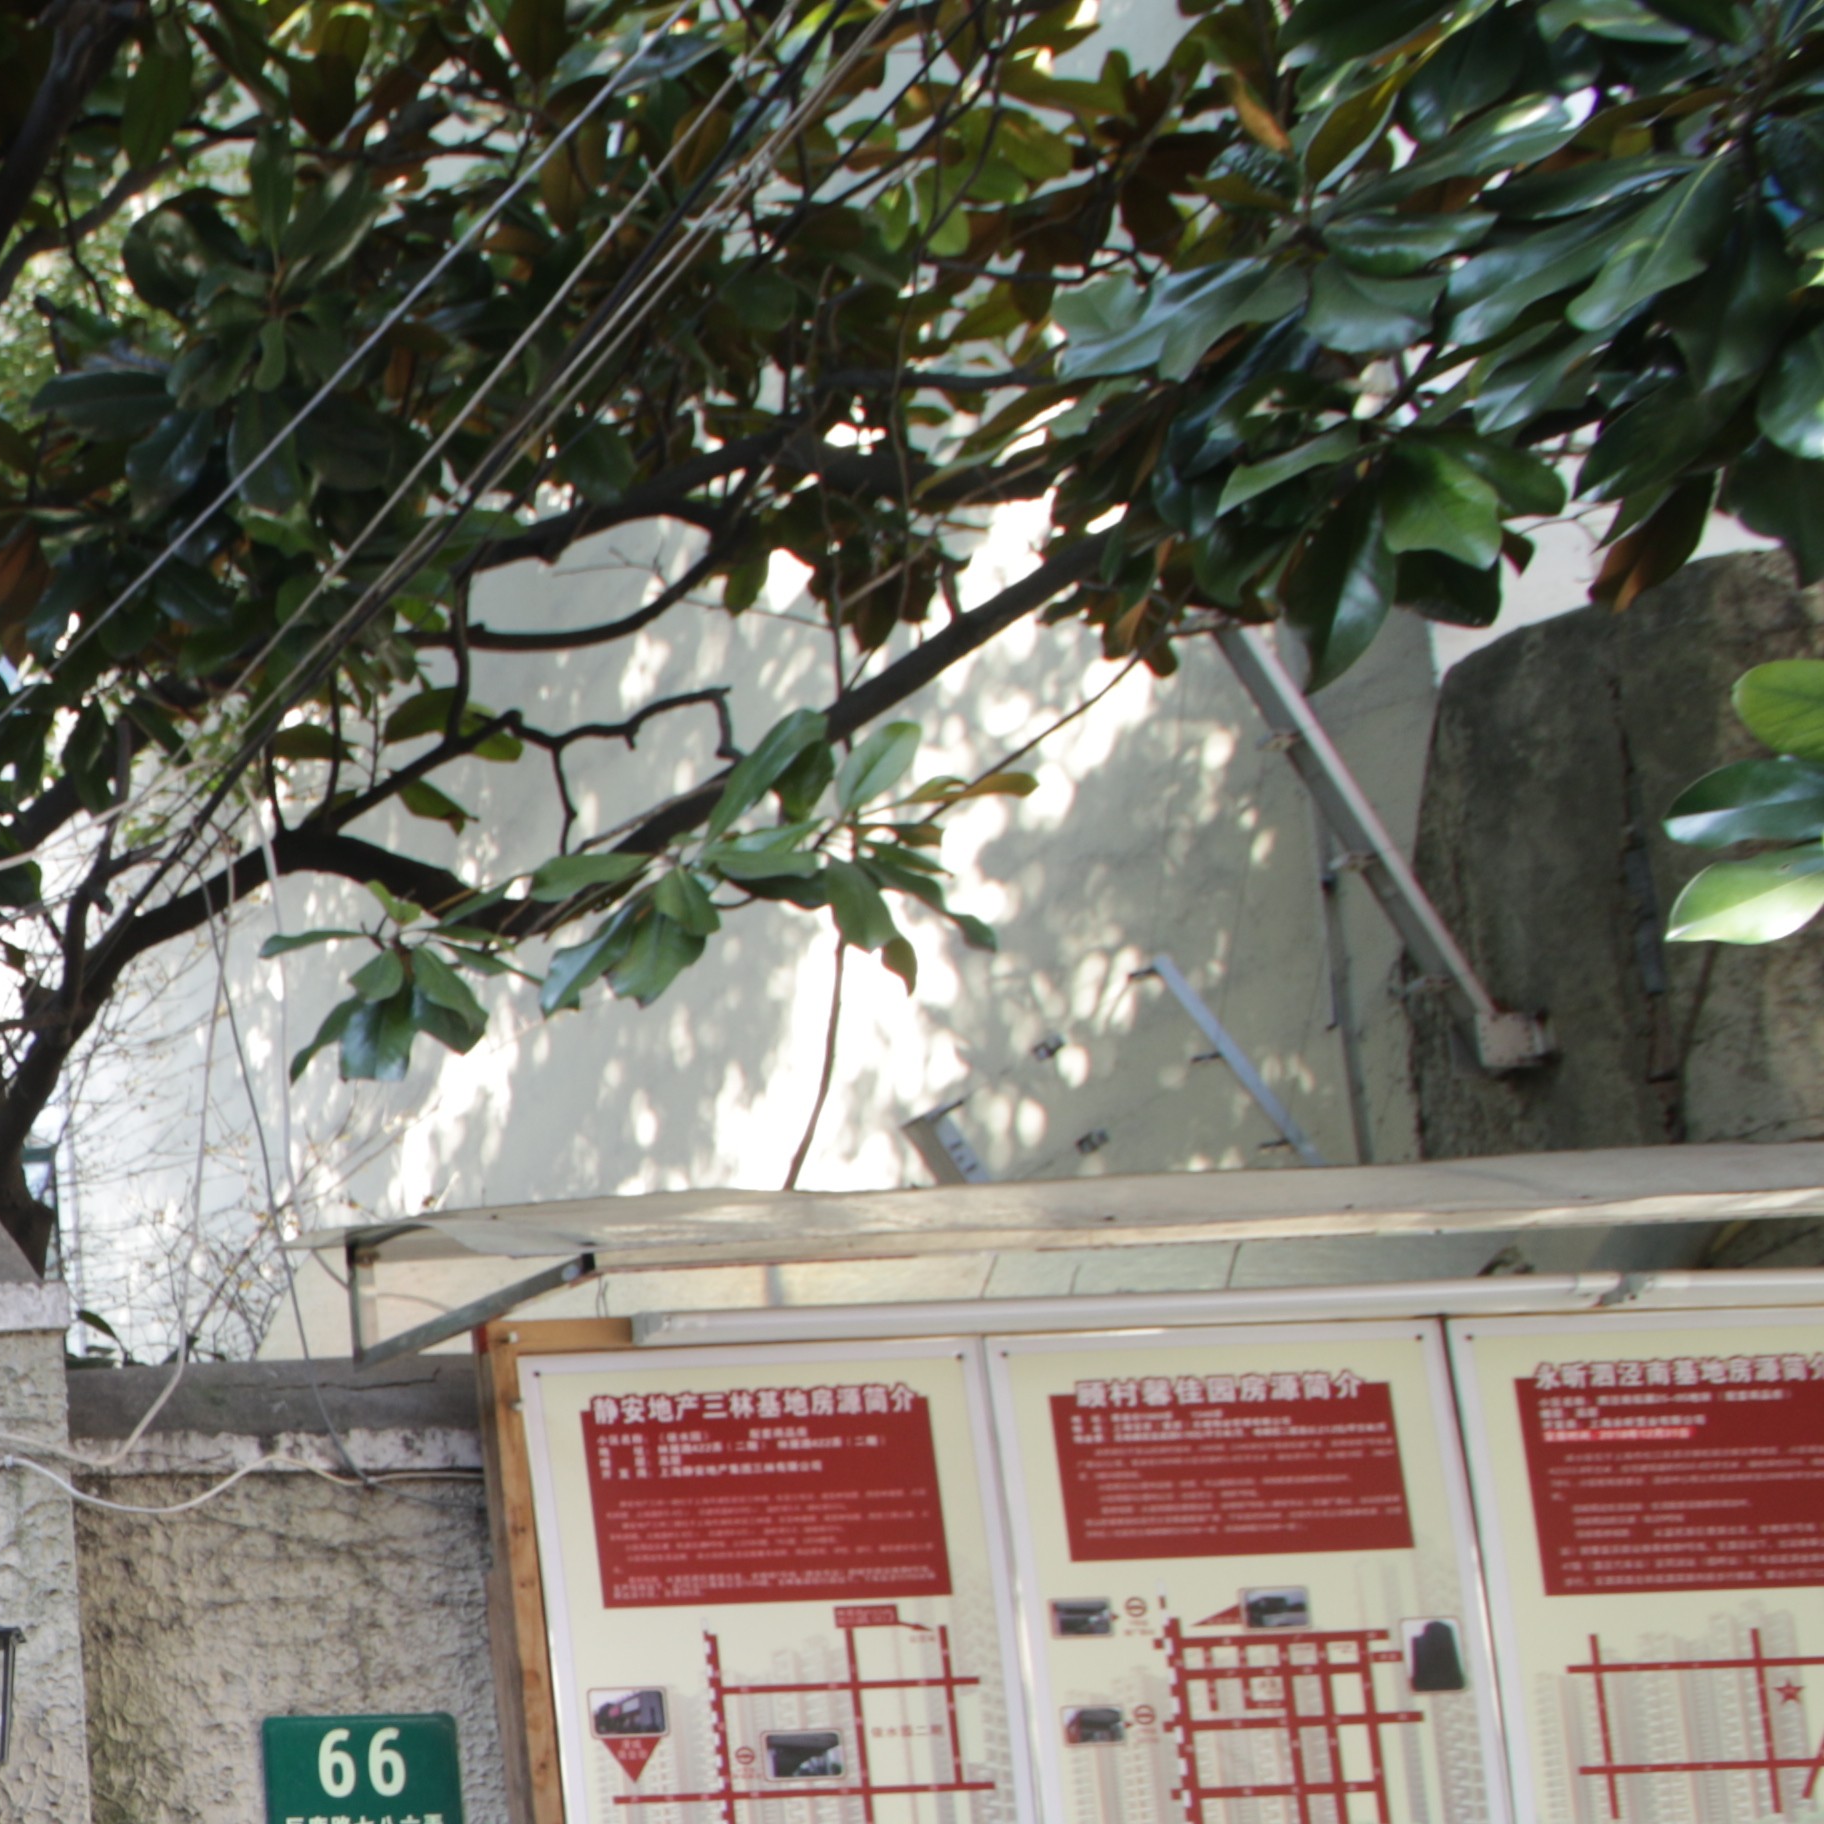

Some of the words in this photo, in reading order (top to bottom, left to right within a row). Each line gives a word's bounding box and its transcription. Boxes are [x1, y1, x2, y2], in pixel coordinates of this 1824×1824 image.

[592, 1384, 915, 1425] 静安地产三林基地房源简介
[1075, 1371, 1364, 1408] 顾村馨佳园房源简介
[318, 1727, 406, 1798] 66
